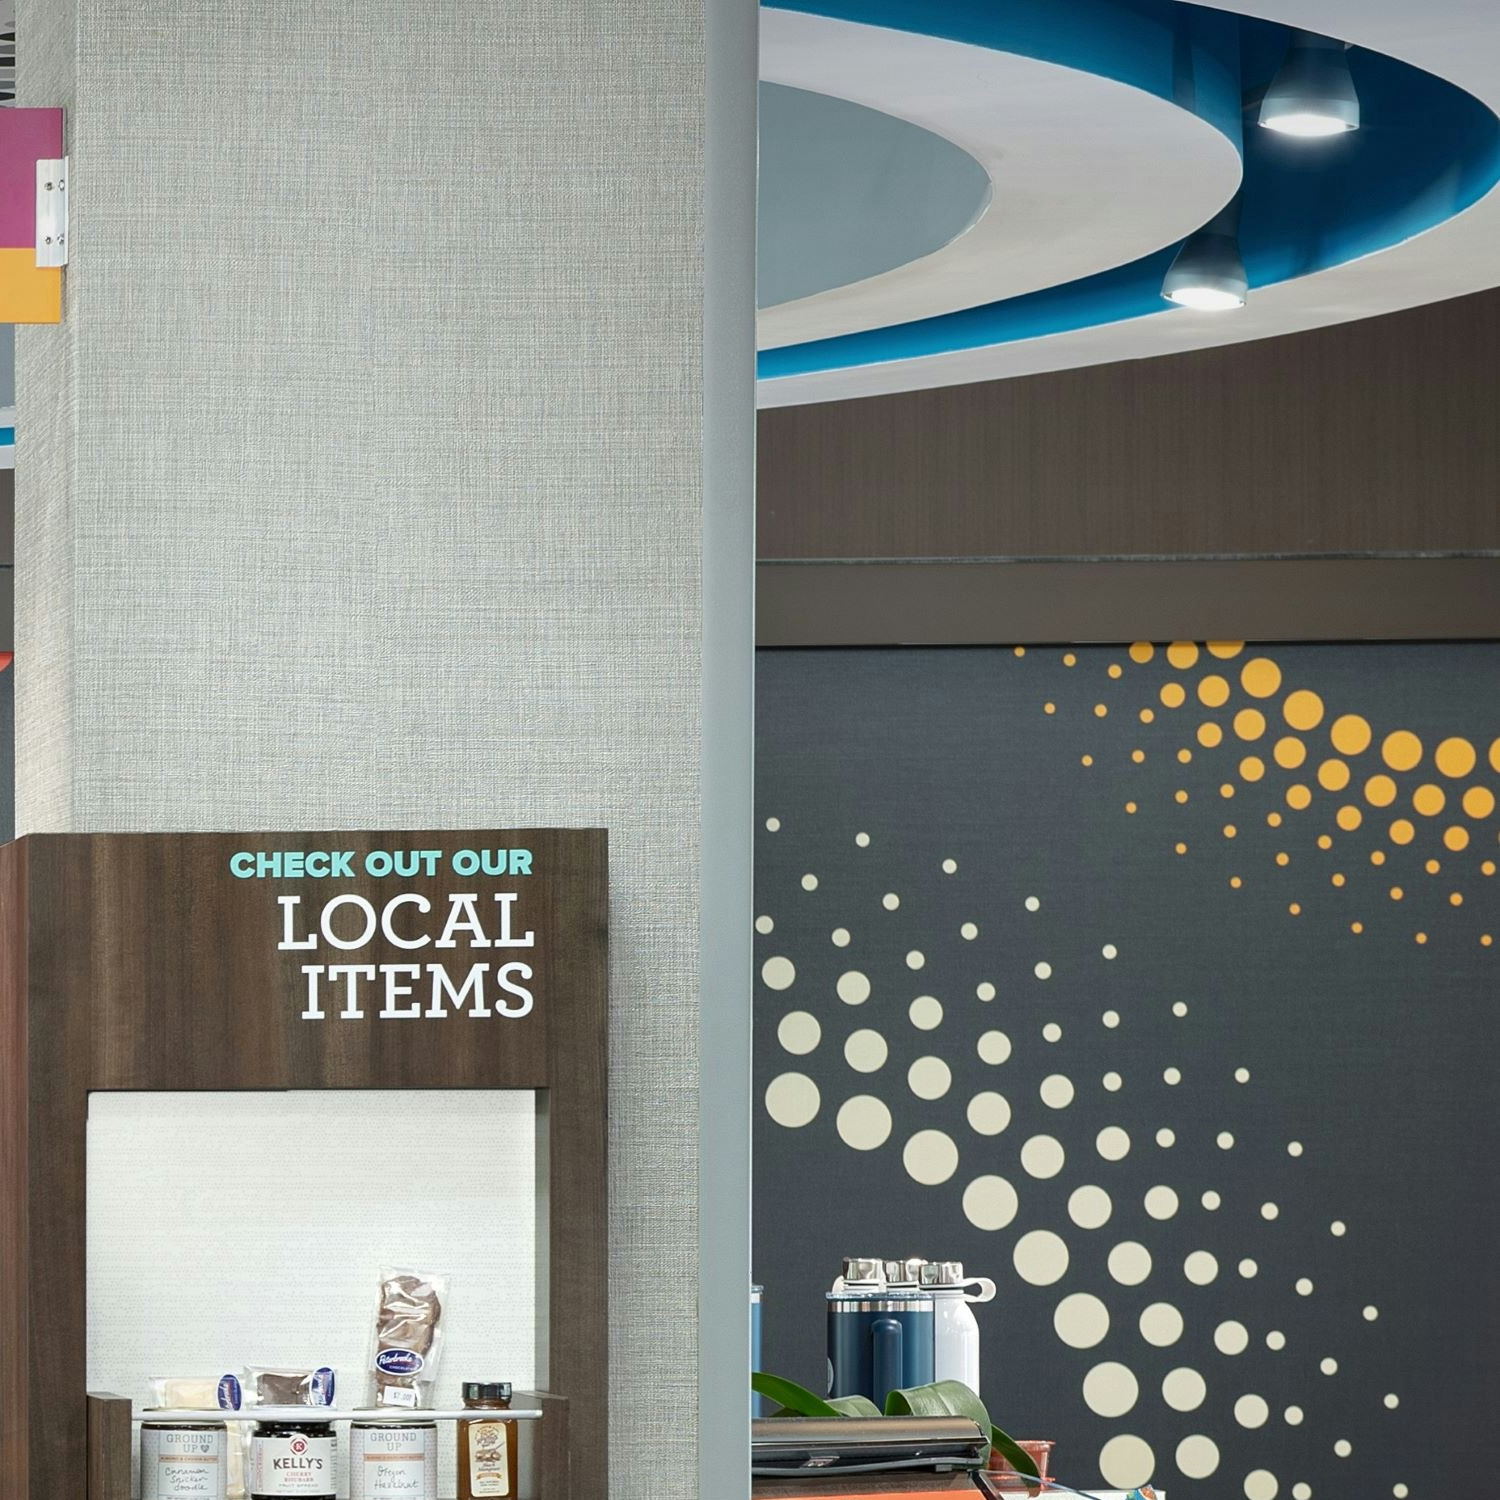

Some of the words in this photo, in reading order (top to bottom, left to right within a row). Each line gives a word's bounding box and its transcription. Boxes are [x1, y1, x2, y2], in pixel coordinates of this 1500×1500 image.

[230, 850, 356, 879] CHECK
[364, 849, 442, 877] OUT
[452, 848, 533, 876] OUR
[277, 892, 535, 950] LOCAL
[301, 961, 534, 1020] ITEMS
[166, 1433, 214, 1444] GROUND
[370, 1432, 417, 1442] GROUND
[273, 1457, 323, 1470] KELLY'S
